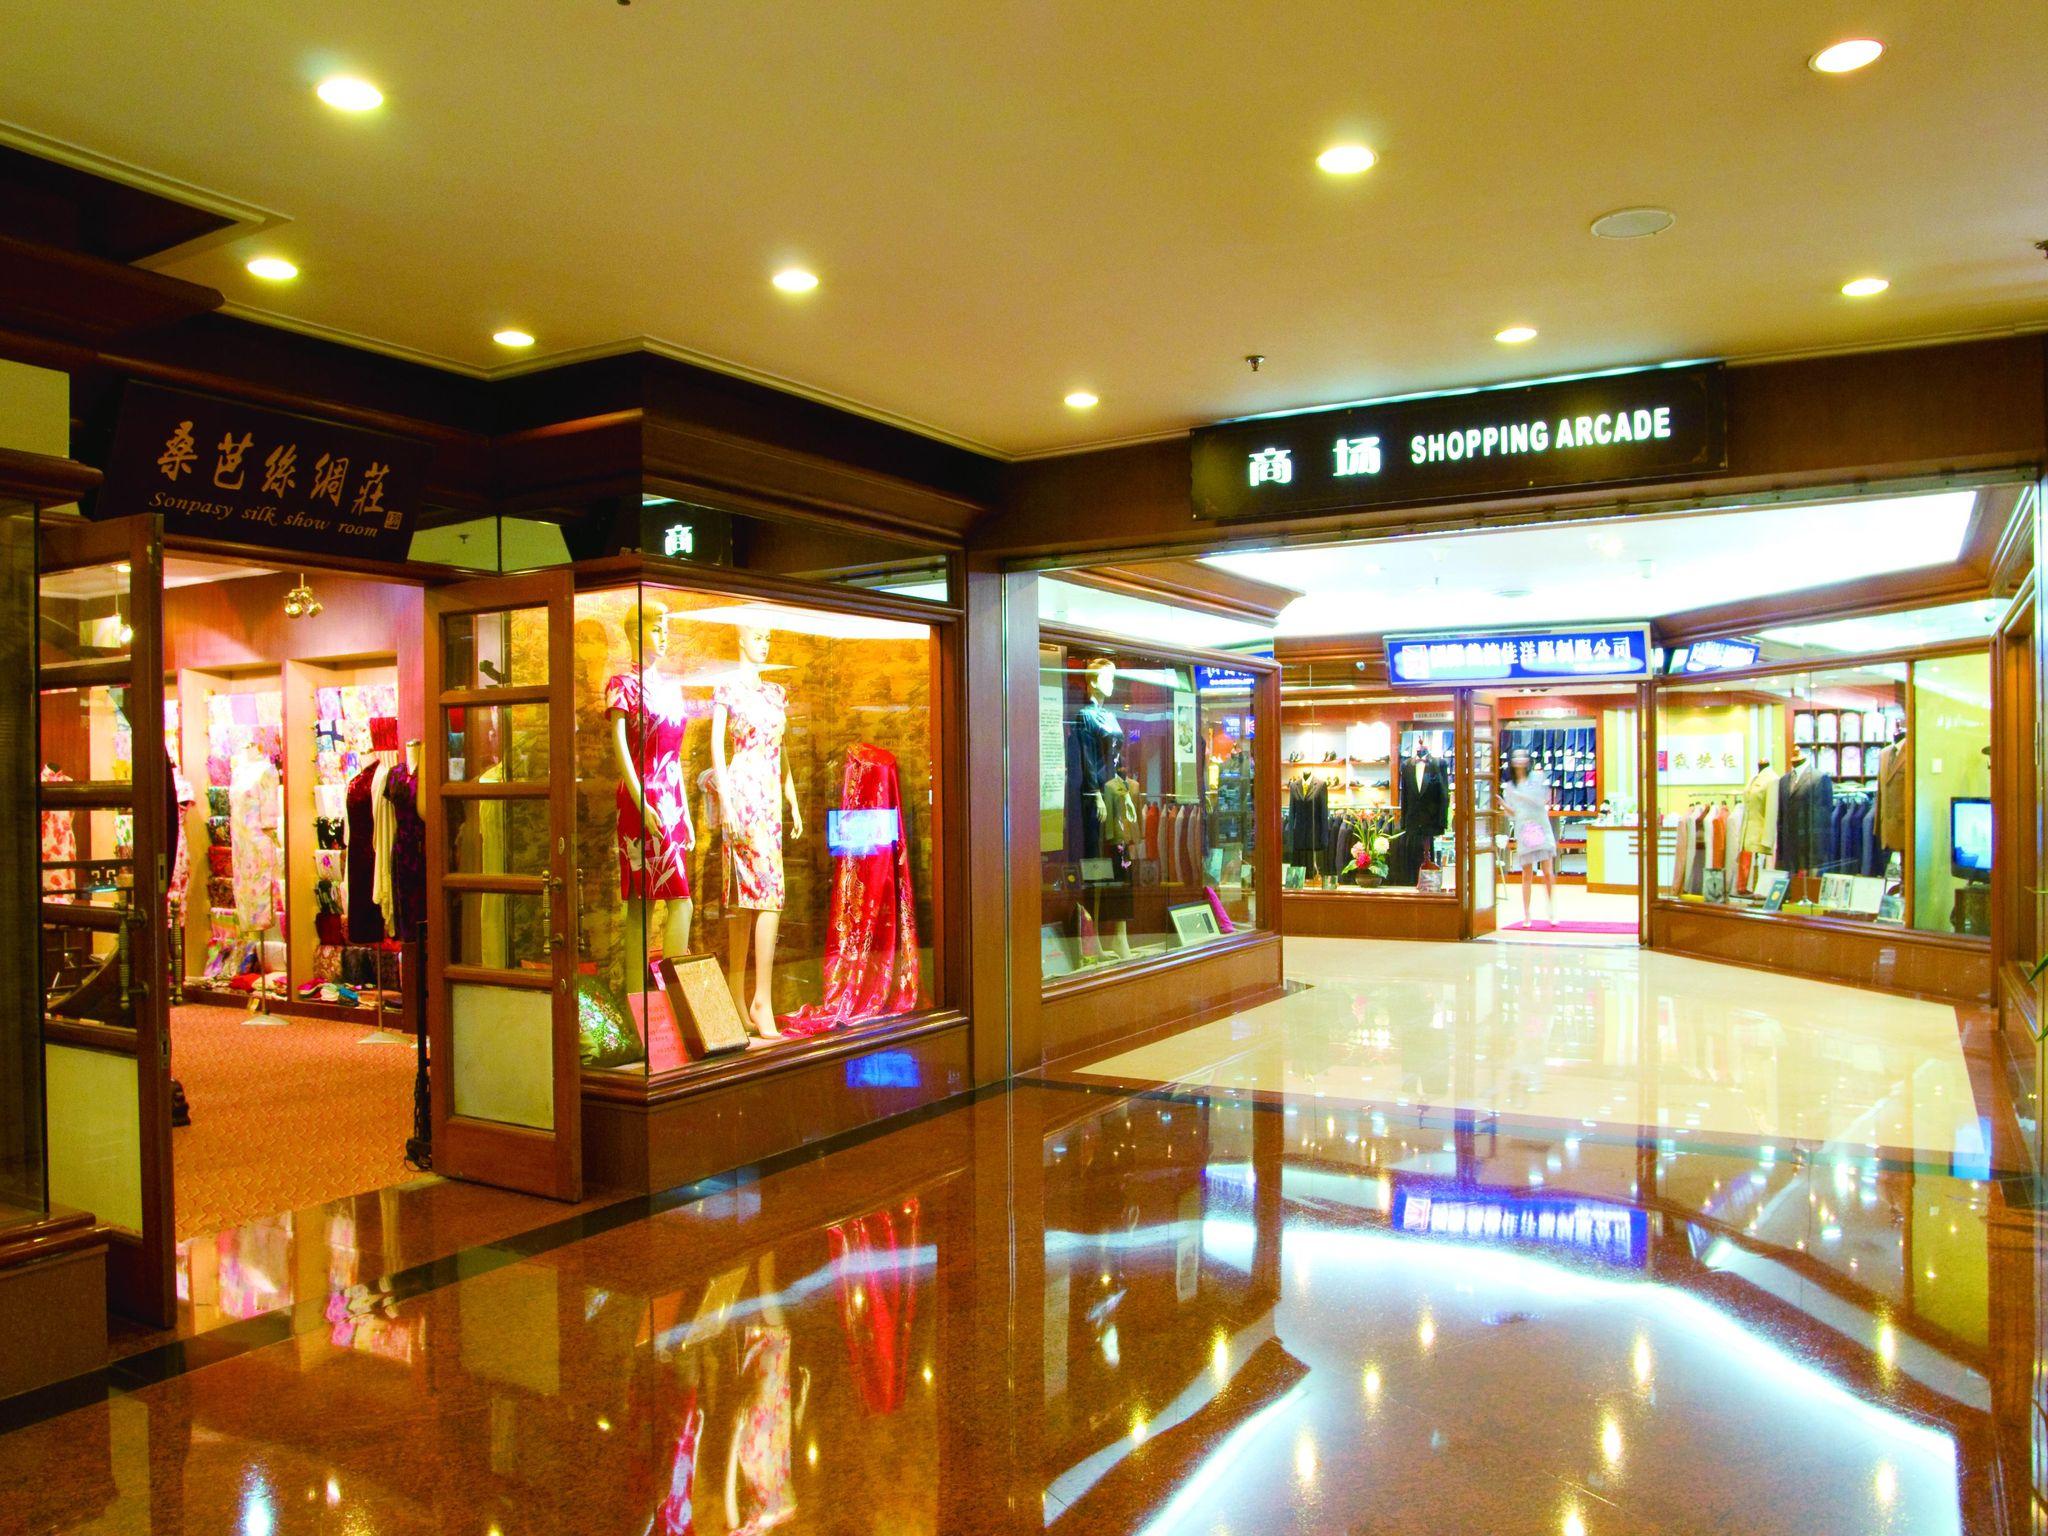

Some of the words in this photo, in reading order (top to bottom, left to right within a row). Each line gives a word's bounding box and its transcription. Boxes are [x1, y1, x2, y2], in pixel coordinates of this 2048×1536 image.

[1410, 420, 1549, 465] SHOPPING
[1555, 406, 1672, 449] ARCADE
[148, 491, 234, 519] Sonpasy
[241, 504, 278, 526] silk
[283, 510, 330, 531] show
[338, 521, 379, 538] room
